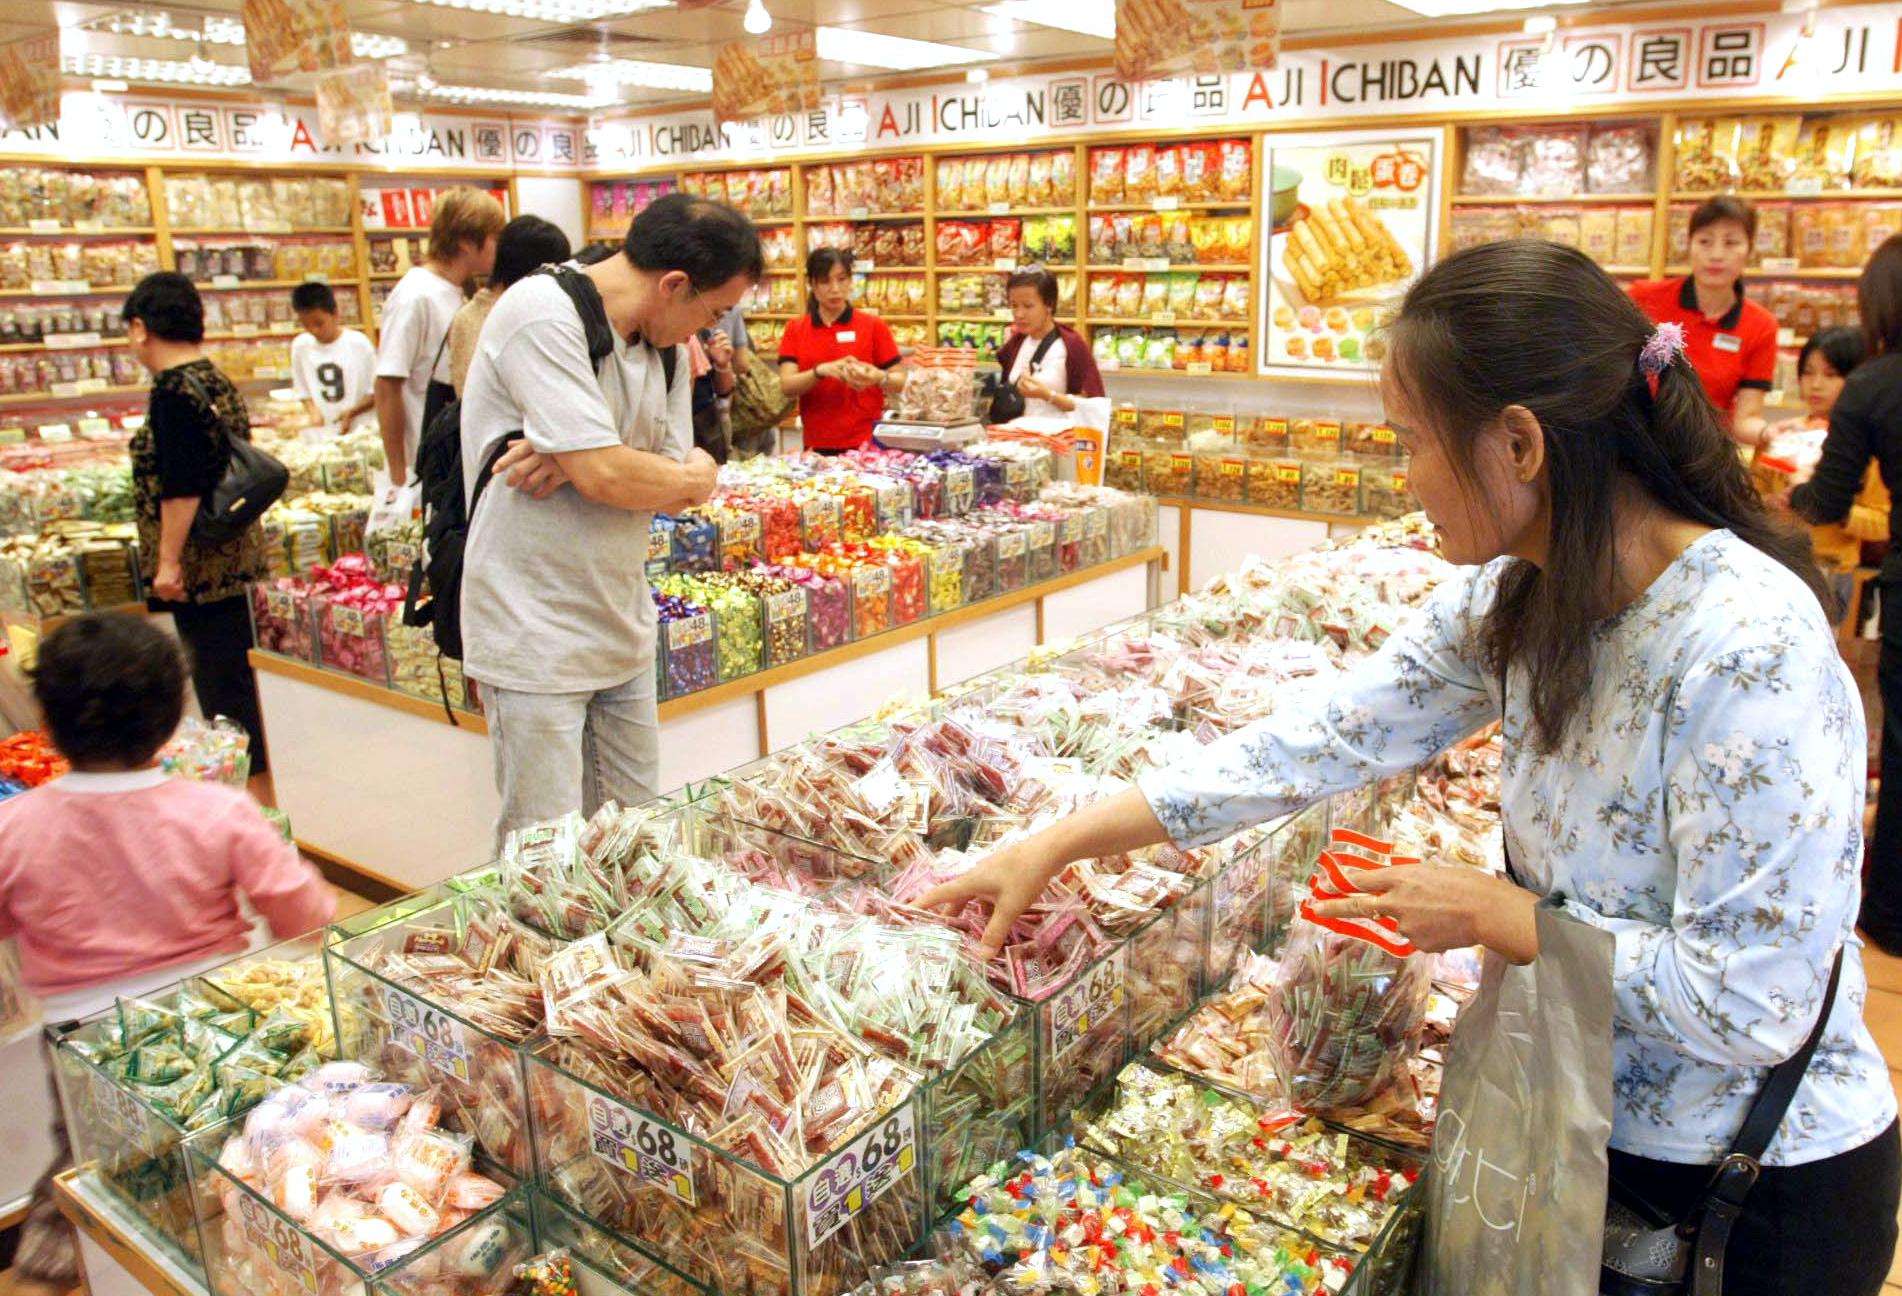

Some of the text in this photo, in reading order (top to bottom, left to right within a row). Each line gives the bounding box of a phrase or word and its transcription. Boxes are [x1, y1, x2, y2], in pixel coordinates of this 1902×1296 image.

[876, 102, 920, 139] AJI
[1054, 75, 1223, 122] 優の品
[1242, 68, 1303, 111] AJI
[1319, 54, 1481, 106] ICHIBAN
[1504, 30, 1752, 91] 優の良品
[103, 110, 264, 147] の良品
[317, 362, 345, 402] 9
[651, 534, 664, 546] 48
